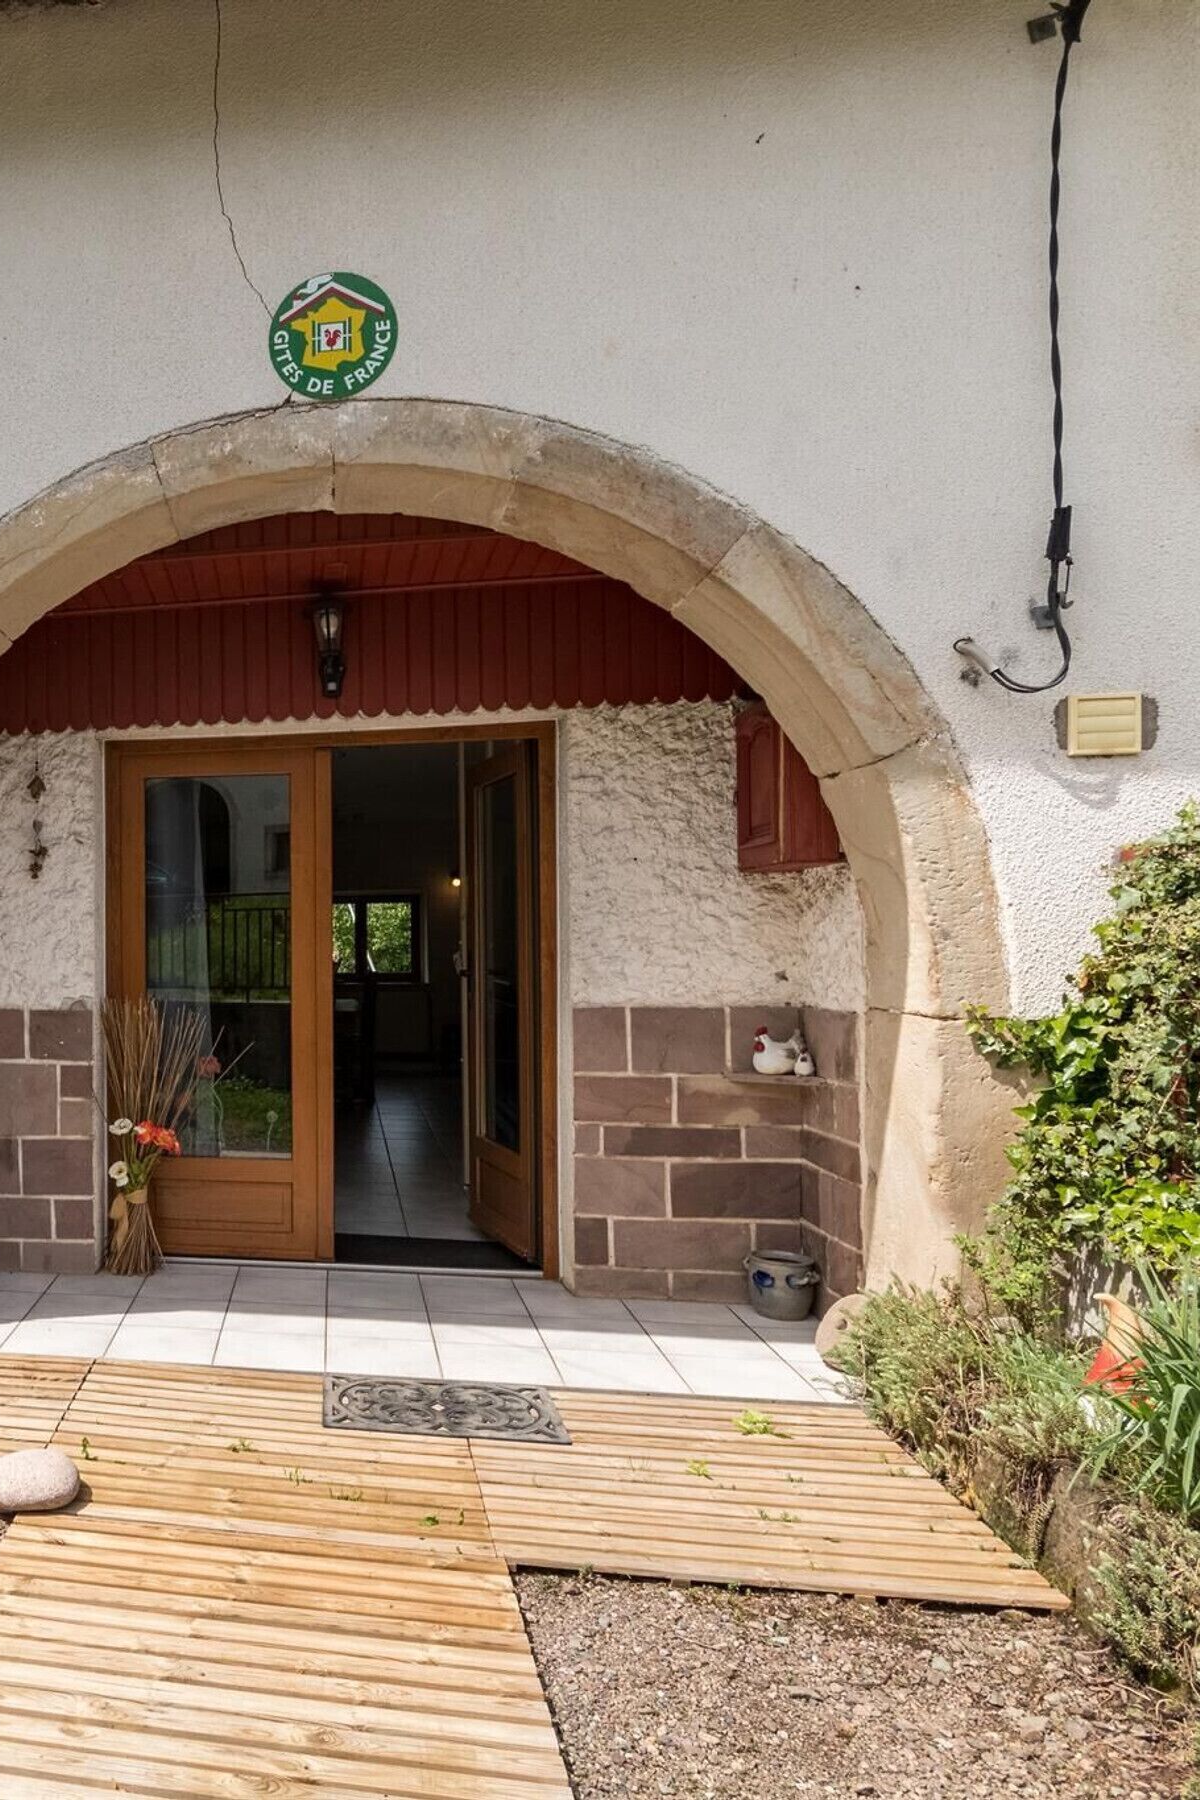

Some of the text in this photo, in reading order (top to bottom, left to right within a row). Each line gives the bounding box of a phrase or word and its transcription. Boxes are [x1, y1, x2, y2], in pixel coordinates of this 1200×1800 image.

[274, 320, 391, 394] GITES DE FRANCE
